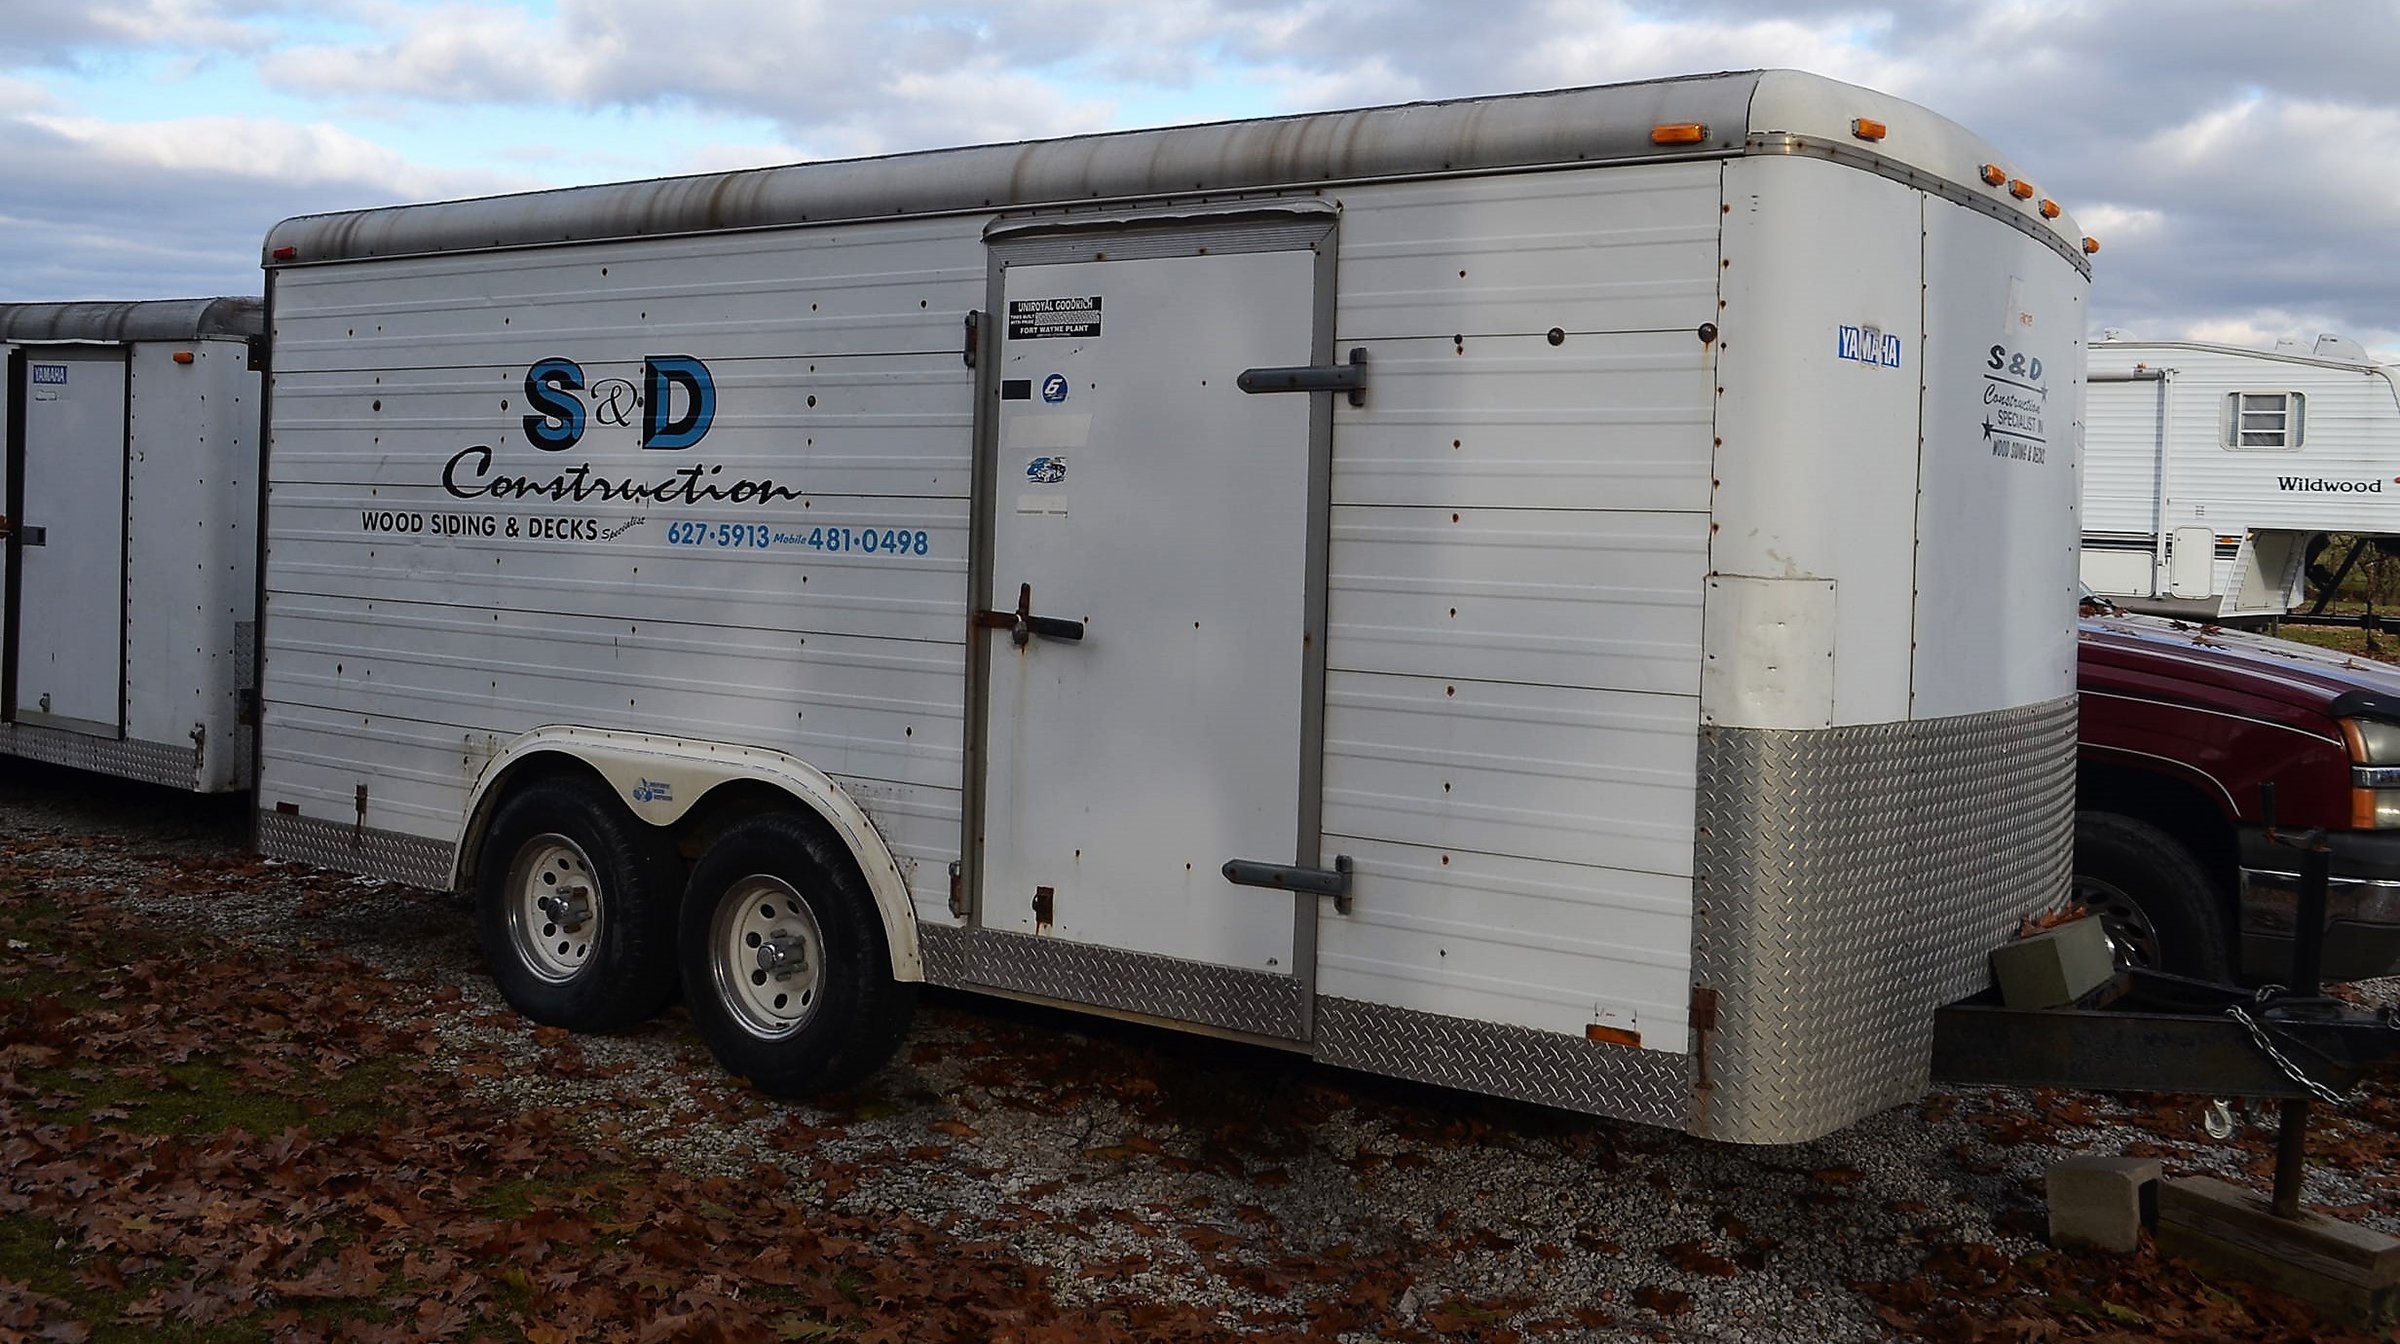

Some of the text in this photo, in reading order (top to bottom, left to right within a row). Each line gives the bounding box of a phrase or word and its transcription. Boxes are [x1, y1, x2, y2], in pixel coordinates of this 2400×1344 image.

[1018, 298, 1093, 312] UNIROYAL GOODRICH
[1020, 324, 1089, 334] FORT WAYNE PLANT
[1841, 327, 1899, 367] YAMAHA
[34, 366, 66, 382] YAMAHA
[1983, 383, 2041, 415] Construction
[1998, 409, 2036, 432] SPECIALIST
[441, 444, 803, 504] Construction
[2277, 476, 2383, 493] Wildwood
[361, 511, 423, 533] WOOD
[431, 513, 497, 538] SIDING
[505, 516, 520, 538] &
[528, 517, 598, 541] DECKS
[773, 533, 807, 545] Mobile
